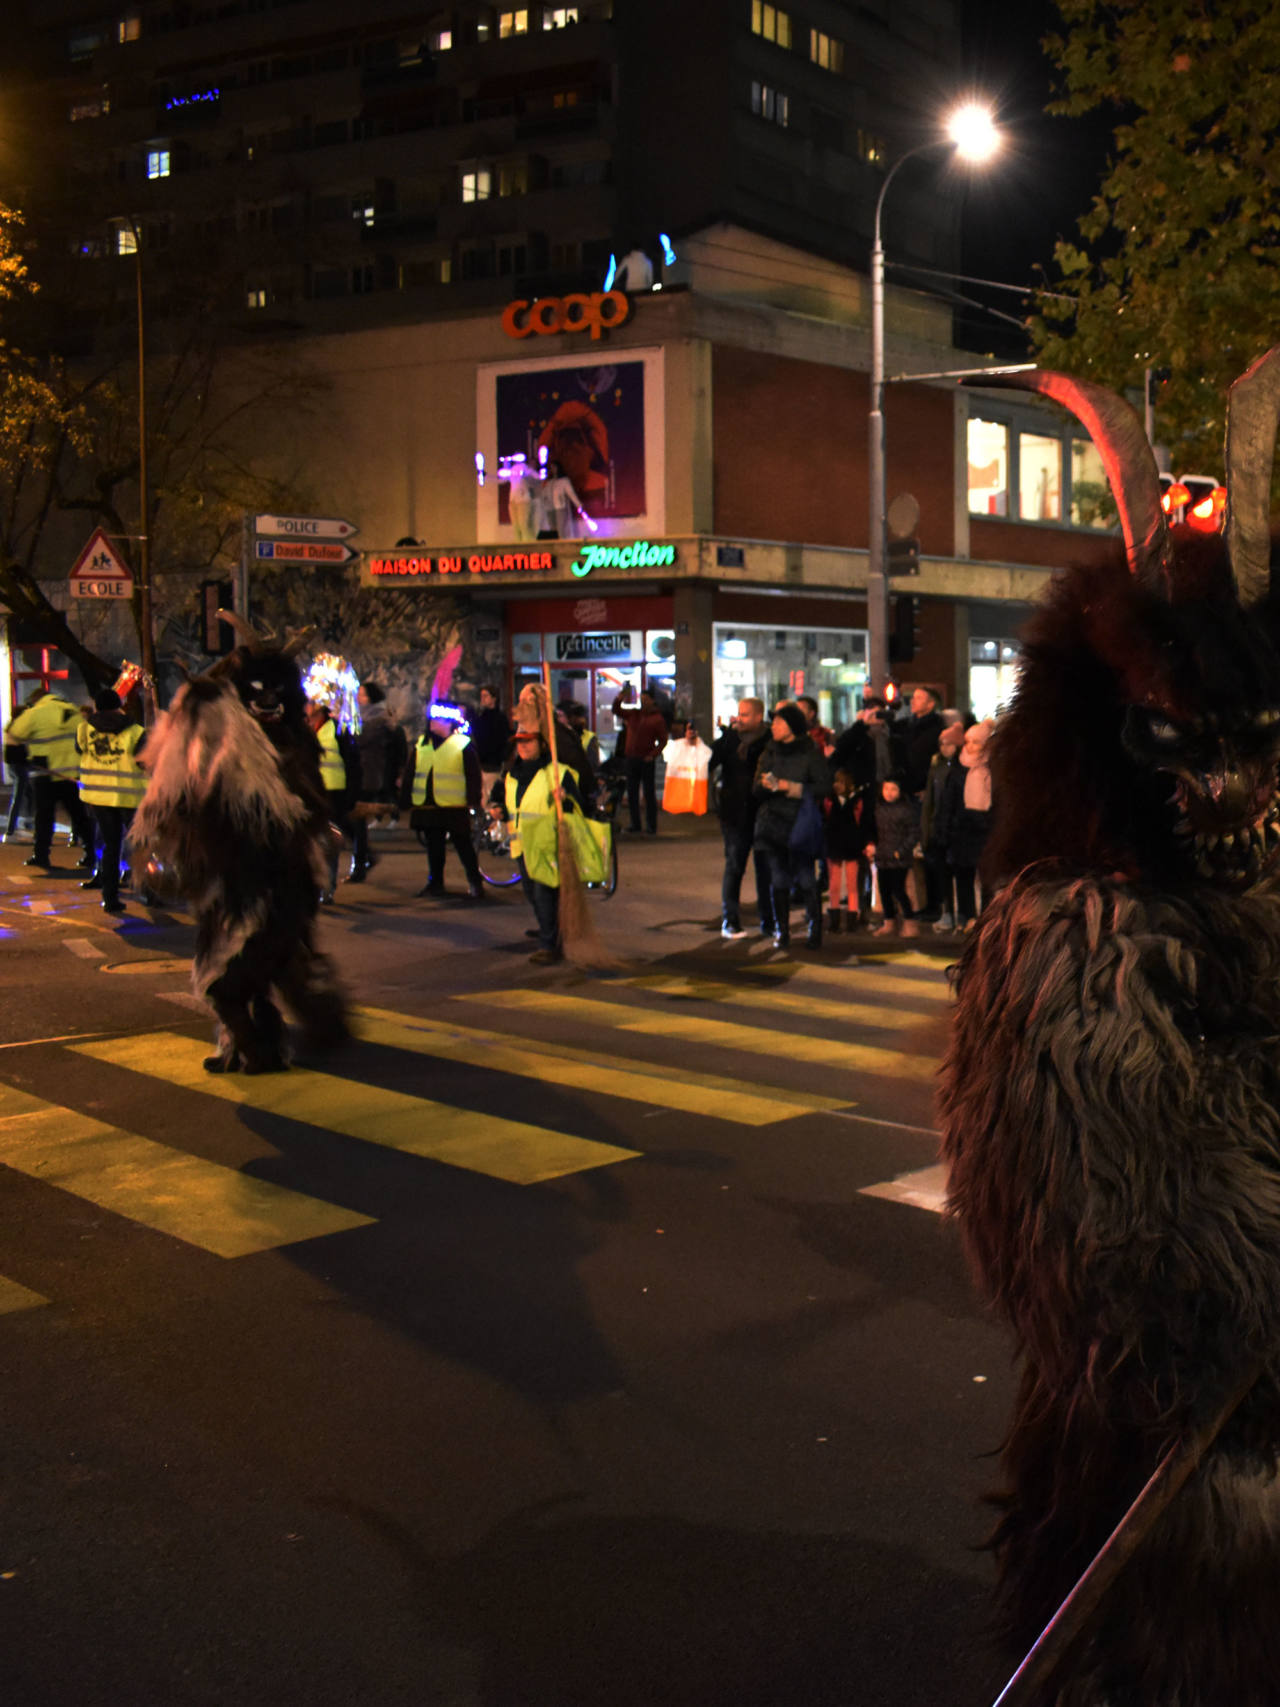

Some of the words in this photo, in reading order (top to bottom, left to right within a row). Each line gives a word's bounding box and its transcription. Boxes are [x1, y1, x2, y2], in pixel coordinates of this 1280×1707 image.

[501, 290, 628, 340] coop
[277, 519, 318, 533] POLICE
[276, 544, 304, 558] David
[308, 546, 343, 560] Dufour
[370, 558, 431, 575] MAISON
[438, 556, 461, 573] DU
[468, 552, 552, 572] QUARTIER
[571, 541, 675, 577] Jonction
[79, 582, 124, 596] ECOLE
